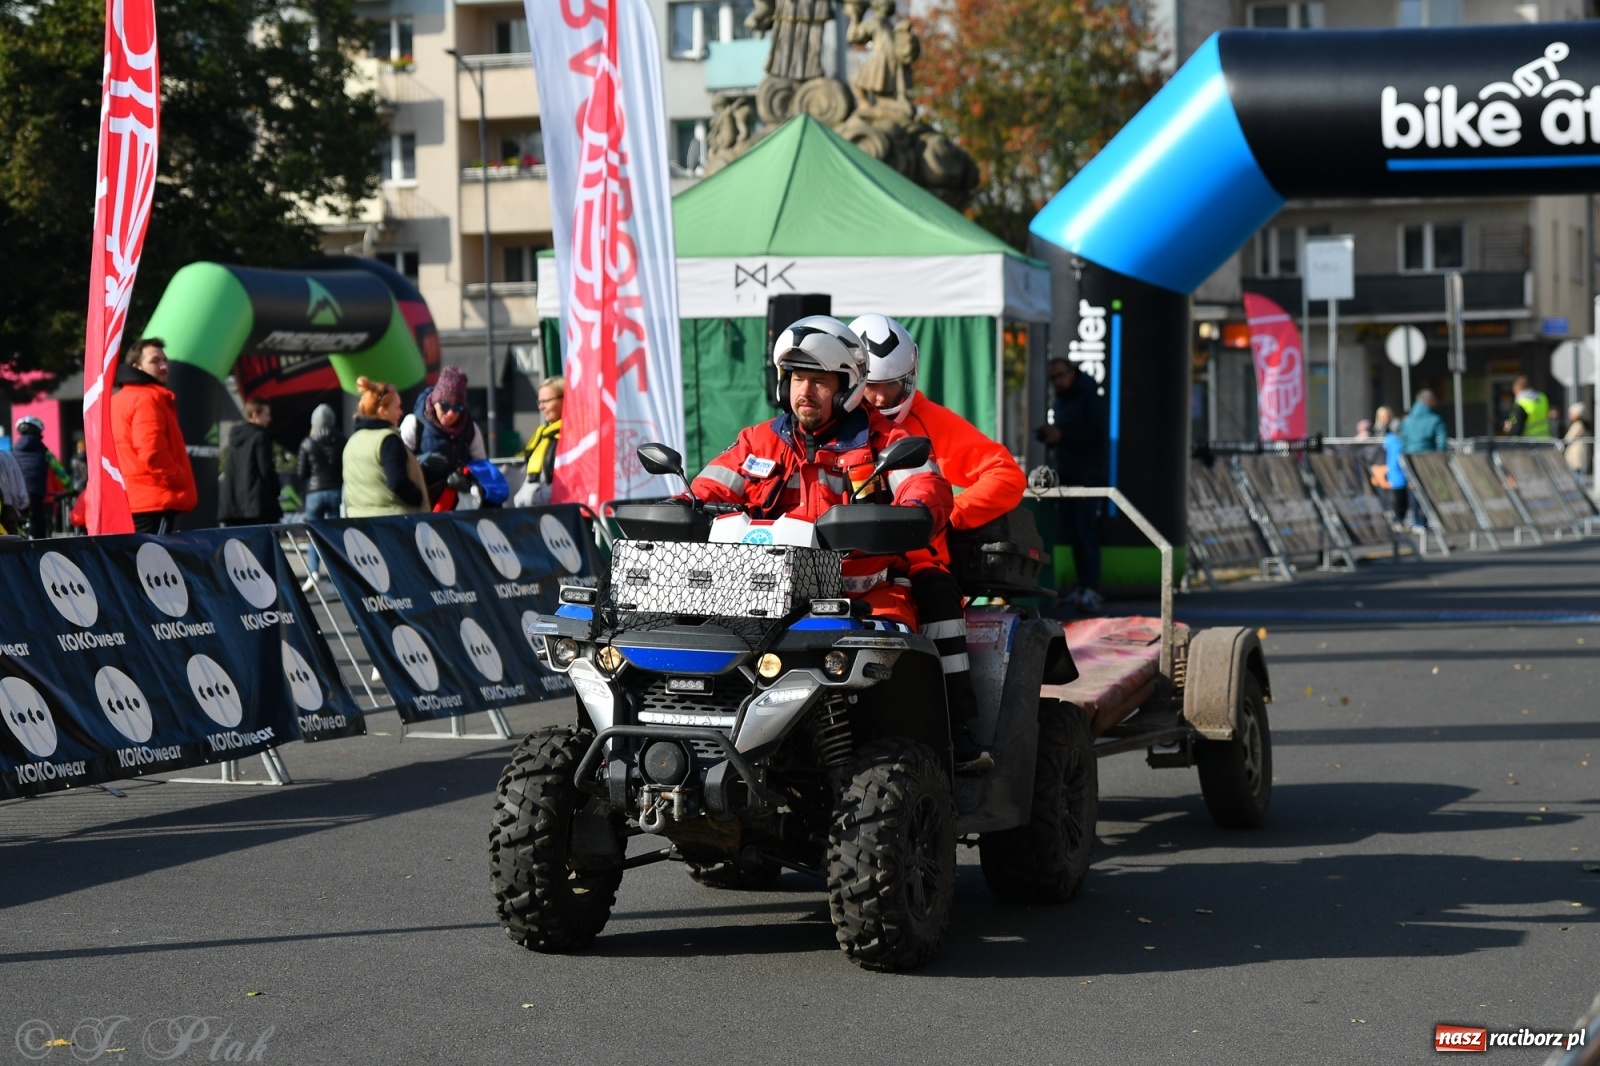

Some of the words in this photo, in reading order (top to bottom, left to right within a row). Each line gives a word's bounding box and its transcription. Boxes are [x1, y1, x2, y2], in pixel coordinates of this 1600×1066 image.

[1381, 84, 1522, 149] bike
[1068, 299, 1107, 396] elier
[430, 589, 477, 606] KOKOwear
[494, 582, 540, 599] KOKOwear
[361, 593, 413, 613] KOKOwear
[151, 620, 216, 641] KOKOwear
[0, 642, 30, 657] wear
[57, 631, 126, 652] KOKOwear
[480, 683, 526, 701] KOKOwear
[412, 694, 463, 711] KOKOwear
[298, 713, 347, 733] OKOwear
[651, 712, 722, 726] LINHAI
[206, 725, 275, 752] KOKOwear
[117, 745, 182, 768] KOKOwear
[14, 760, 87, 784] KOKOwear
